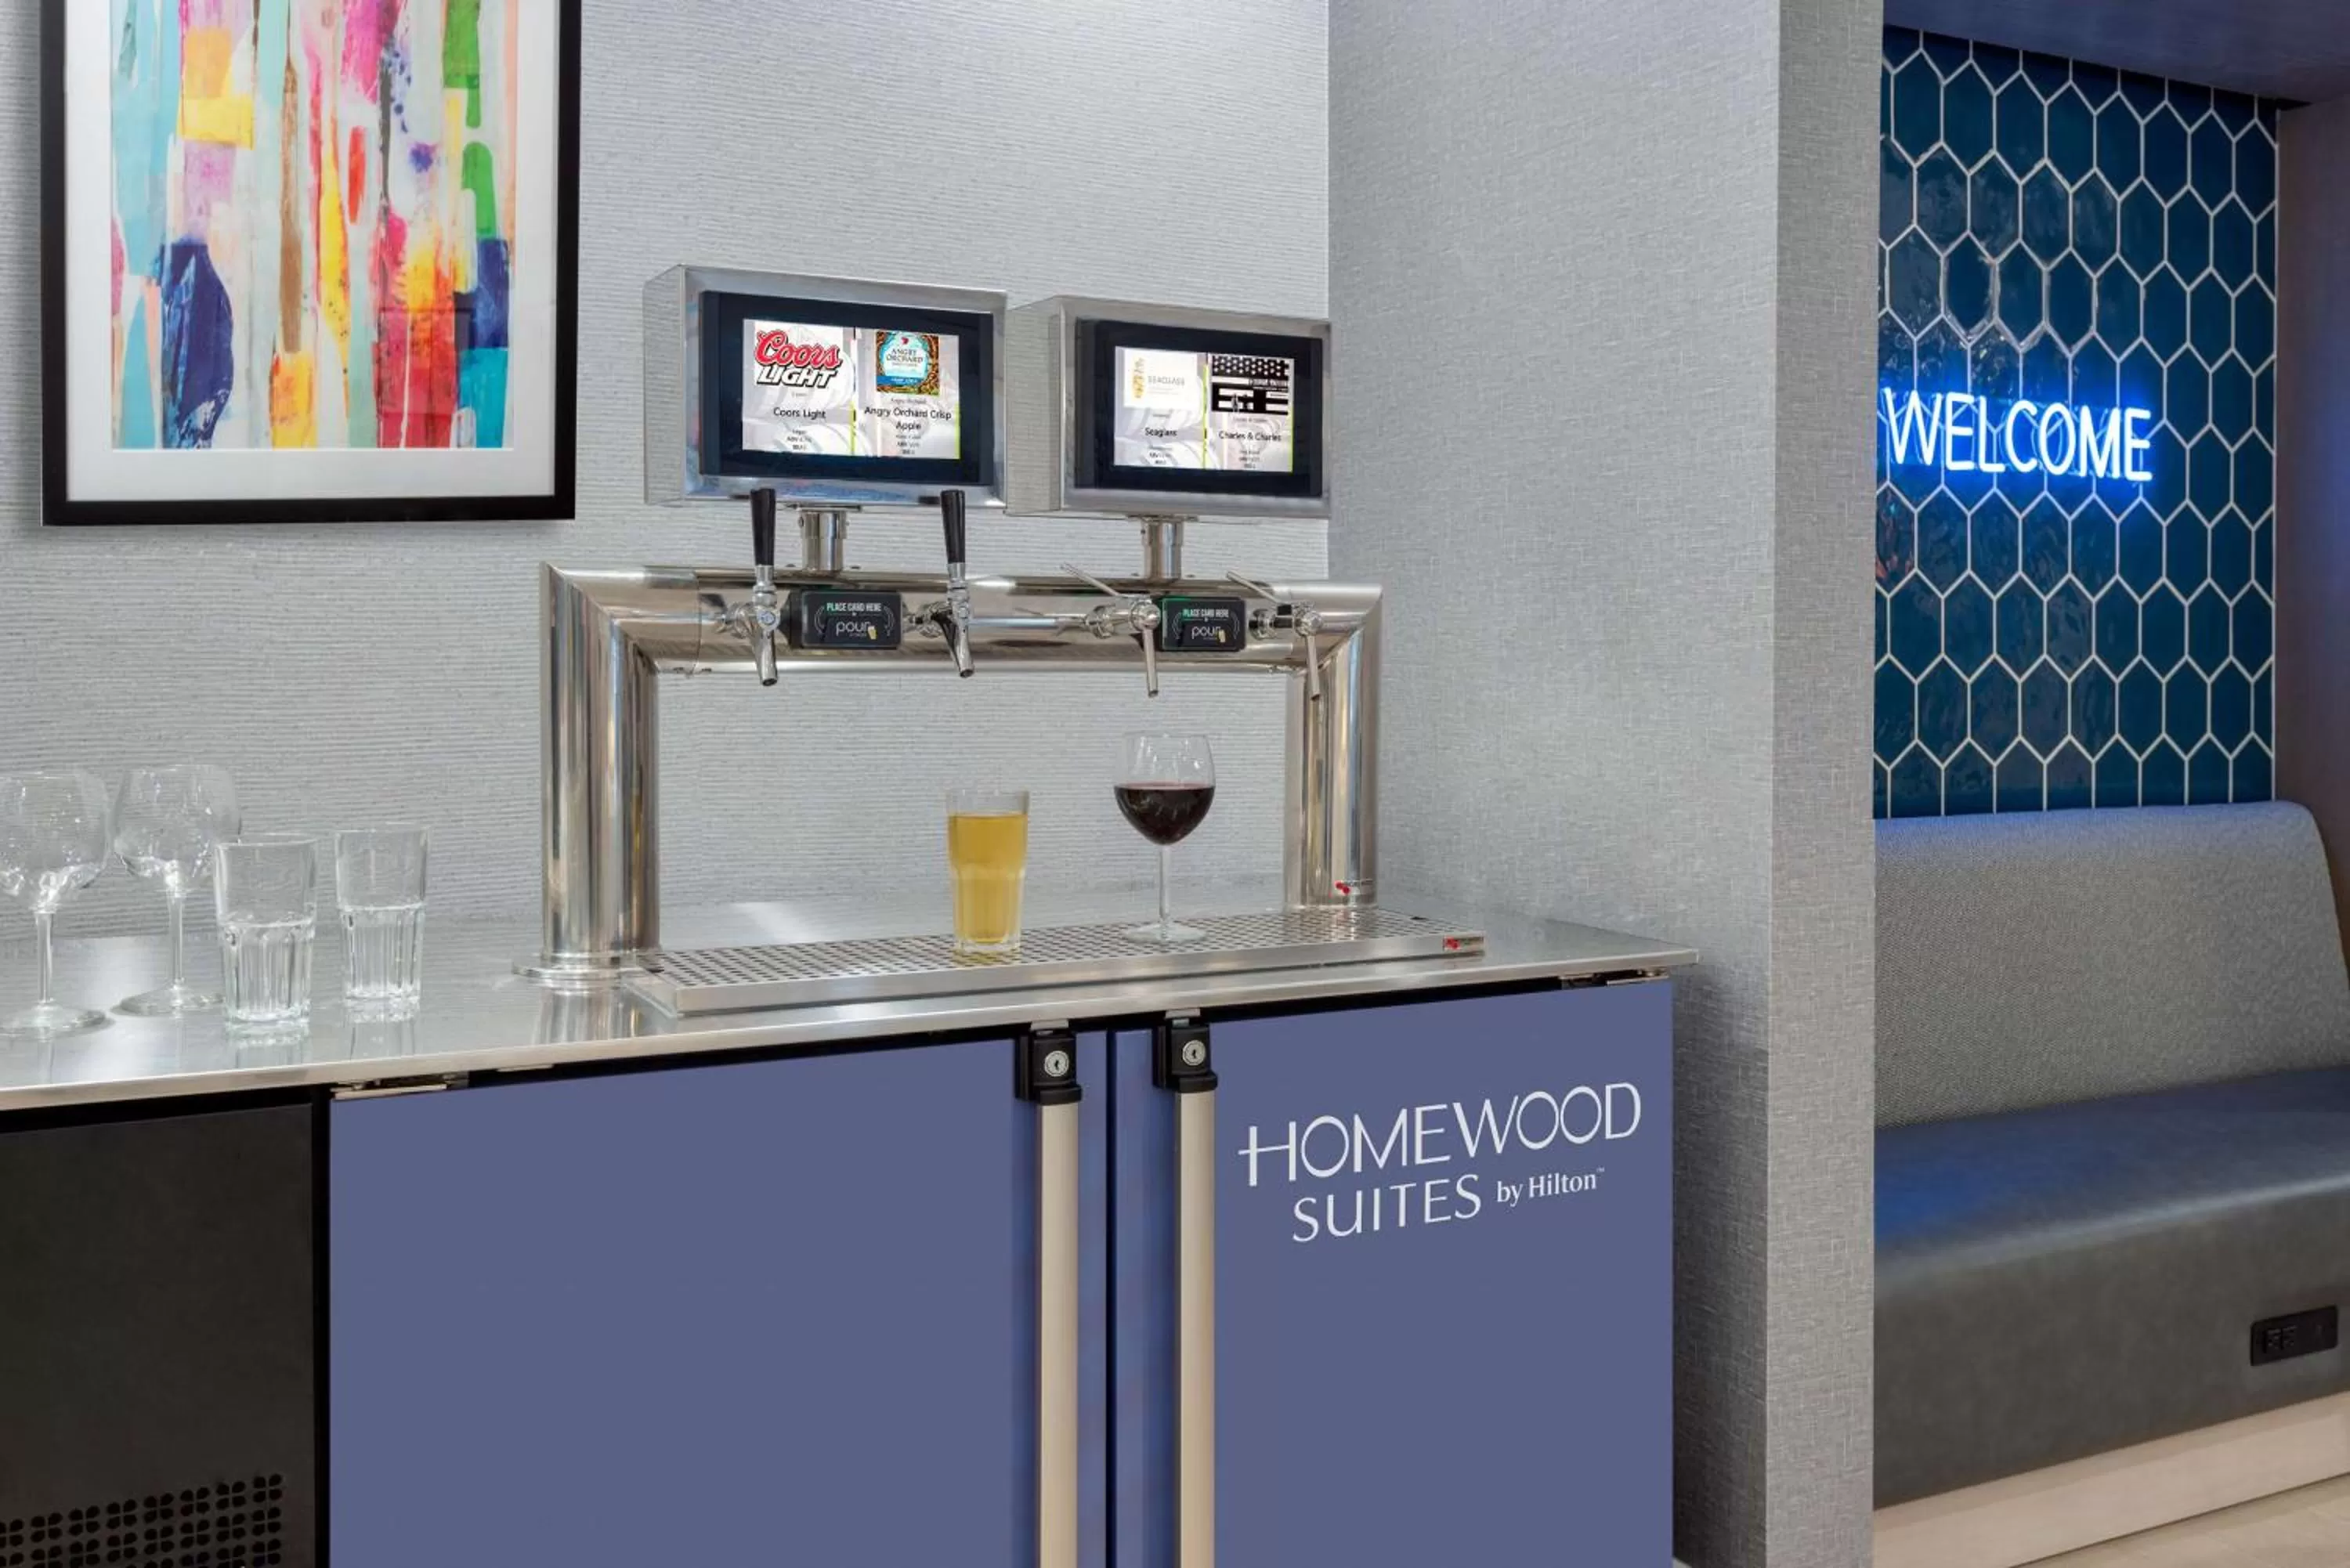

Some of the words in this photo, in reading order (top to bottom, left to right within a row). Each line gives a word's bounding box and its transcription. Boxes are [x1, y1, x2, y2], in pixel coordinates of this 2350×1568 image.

[755, 329, 843, 370] Coors
[886, 353, 924, 363] ORCHARD
[757, 365, 838, 388] LIGHT
[773, 406, 800, 417] Coors
[803, 409, 826, 420] Light
[864, 406, 891, 417] Angry
[893, 407, 927, 417] Orchard
[930, 410, 952, 420] Crisp
[895, 421, 921, 431] Apple
[1219, 430, 1246, 439] Charles
[1255, 432, 1282, 442] Charles
[1882, 386, 2153, 481] WELCOME
[826, 602, 847, 611] PLACE
[848, 602, 865, 611] CARD
[866, 603, 881, 612] HERE
[1182, 609, 1200, 617] PLACE
[836, 621, 870, 636] pour
[1191, 626, 1221, 639] pour
[1238, 1082, 1641, 1187] HOMEWOOD
[1292, 1174, 1482, 1242] SUITES
[1497, 1180, 1523, 1207] by
